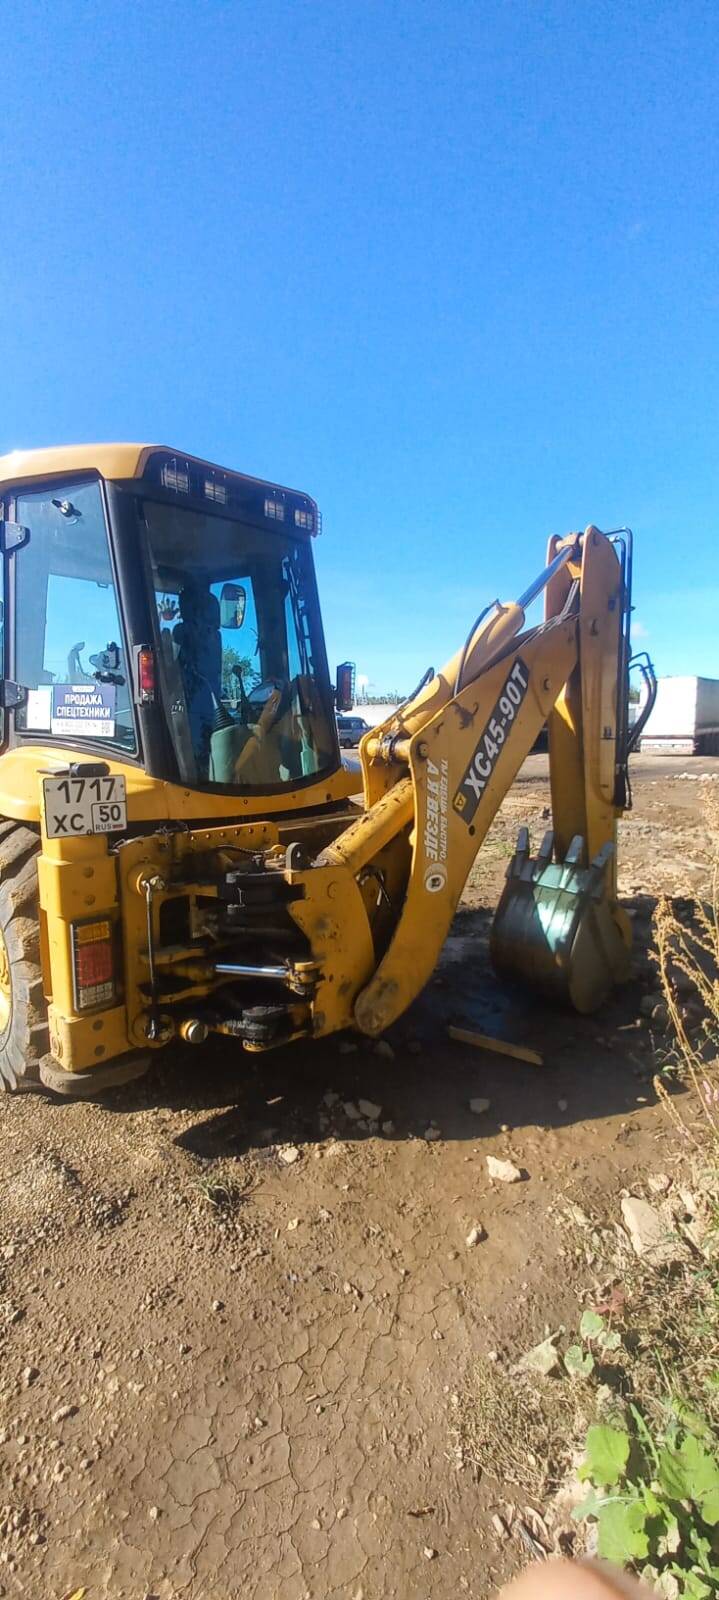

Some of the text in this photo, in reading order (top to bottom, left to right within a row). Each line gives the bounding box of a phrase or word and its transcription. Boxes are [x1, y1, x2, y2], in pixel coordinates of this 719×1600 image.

[64, 694, 103, 706] ПРОДАЖА
[56, 706, 111, 718] СПЕЦТЕХНИКИ
[57, 778, 116, 804] 1717
[99, 804, 121, 822] 50
[424, 759, 439, 861] А Я ВЕЗДЕ
[95, 820, 112, 831] RUS
